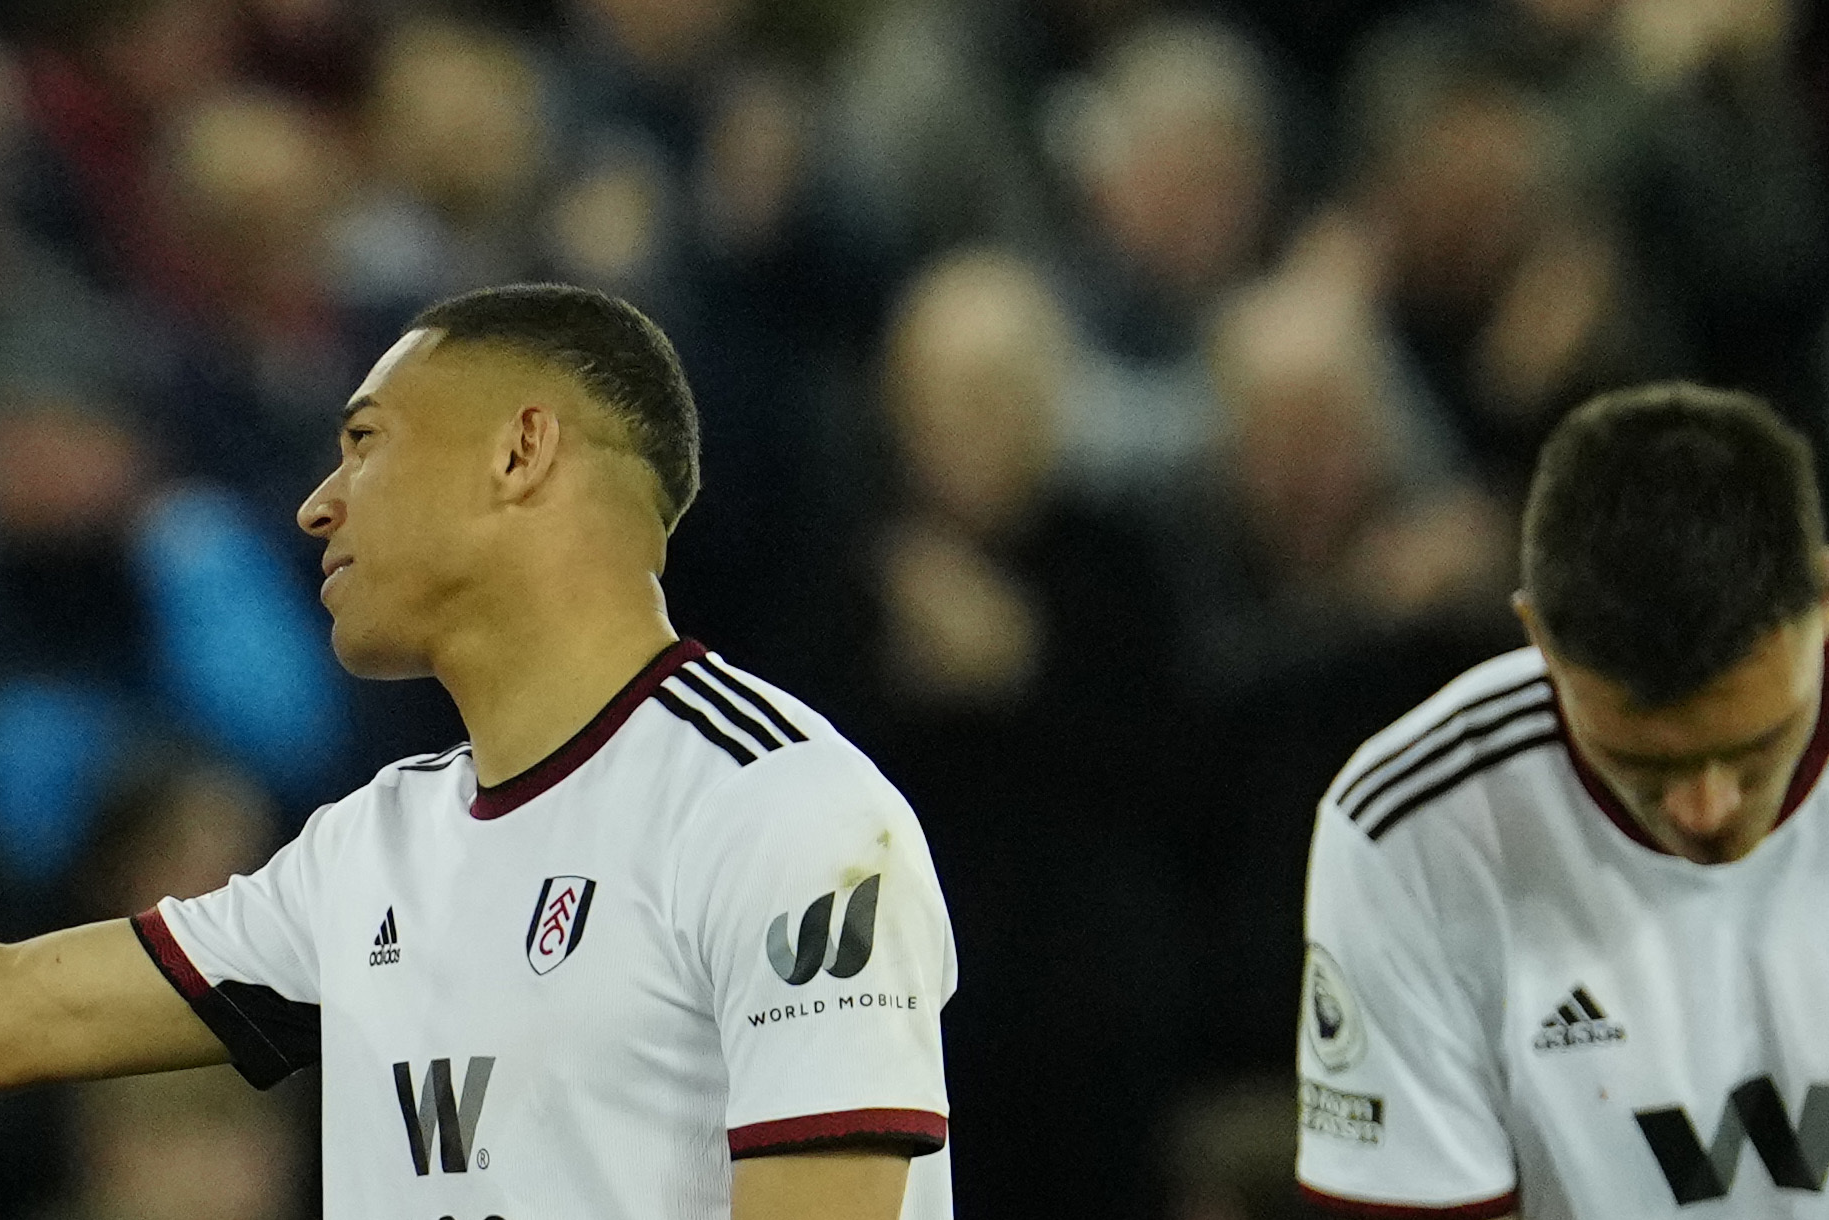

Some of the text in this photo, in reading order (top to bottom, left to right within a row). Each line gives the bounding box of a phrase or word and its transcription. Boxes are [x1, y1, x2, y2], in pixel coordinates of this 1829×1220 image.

[369, 943, 401, 967] adidas
[748, 993, 918, 1027] WORLD MOBILE
